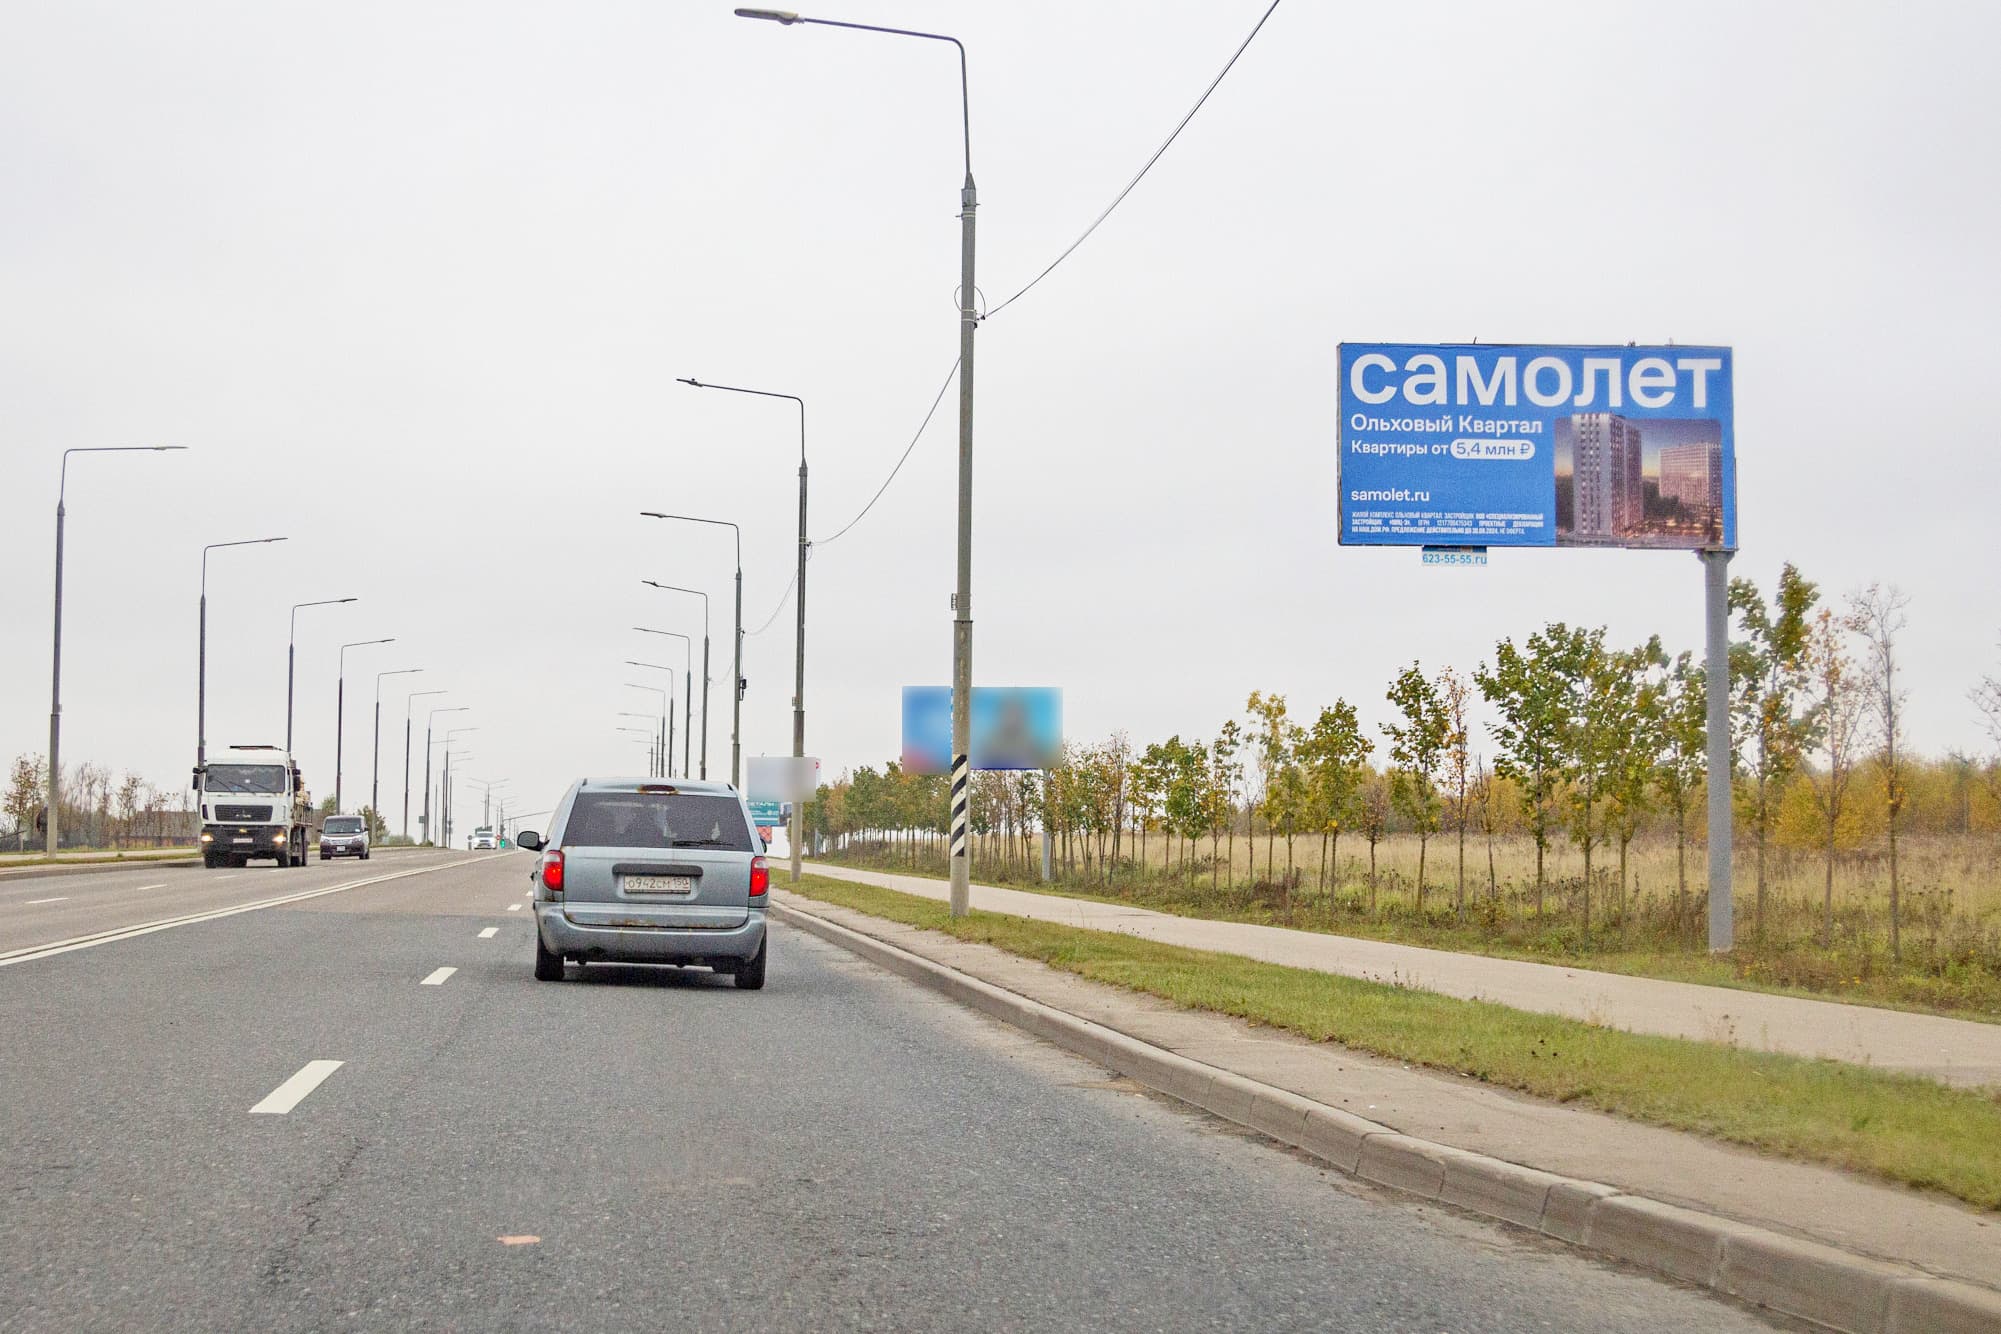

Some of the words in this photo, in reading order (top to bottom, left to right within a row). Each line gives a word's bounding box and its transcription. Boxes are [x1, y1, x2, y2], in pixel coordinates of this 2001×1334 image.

[1350, 353, 1722, 408] самолет
[1351, 413, 1453, 432] Ольховый
[1459, 415, 1542, 437] Квартал
[1351, 440, 1428, 457] Квартиры
[1431, 444, 1448, 455] от
[1456, 442, 1481, 457] 5,4
[1485, 446, 1516, 456] млн
[1351, 488, 1430, 501] samolet.ru
[1422, 553, 1487, 565] 623-55-55.ru
